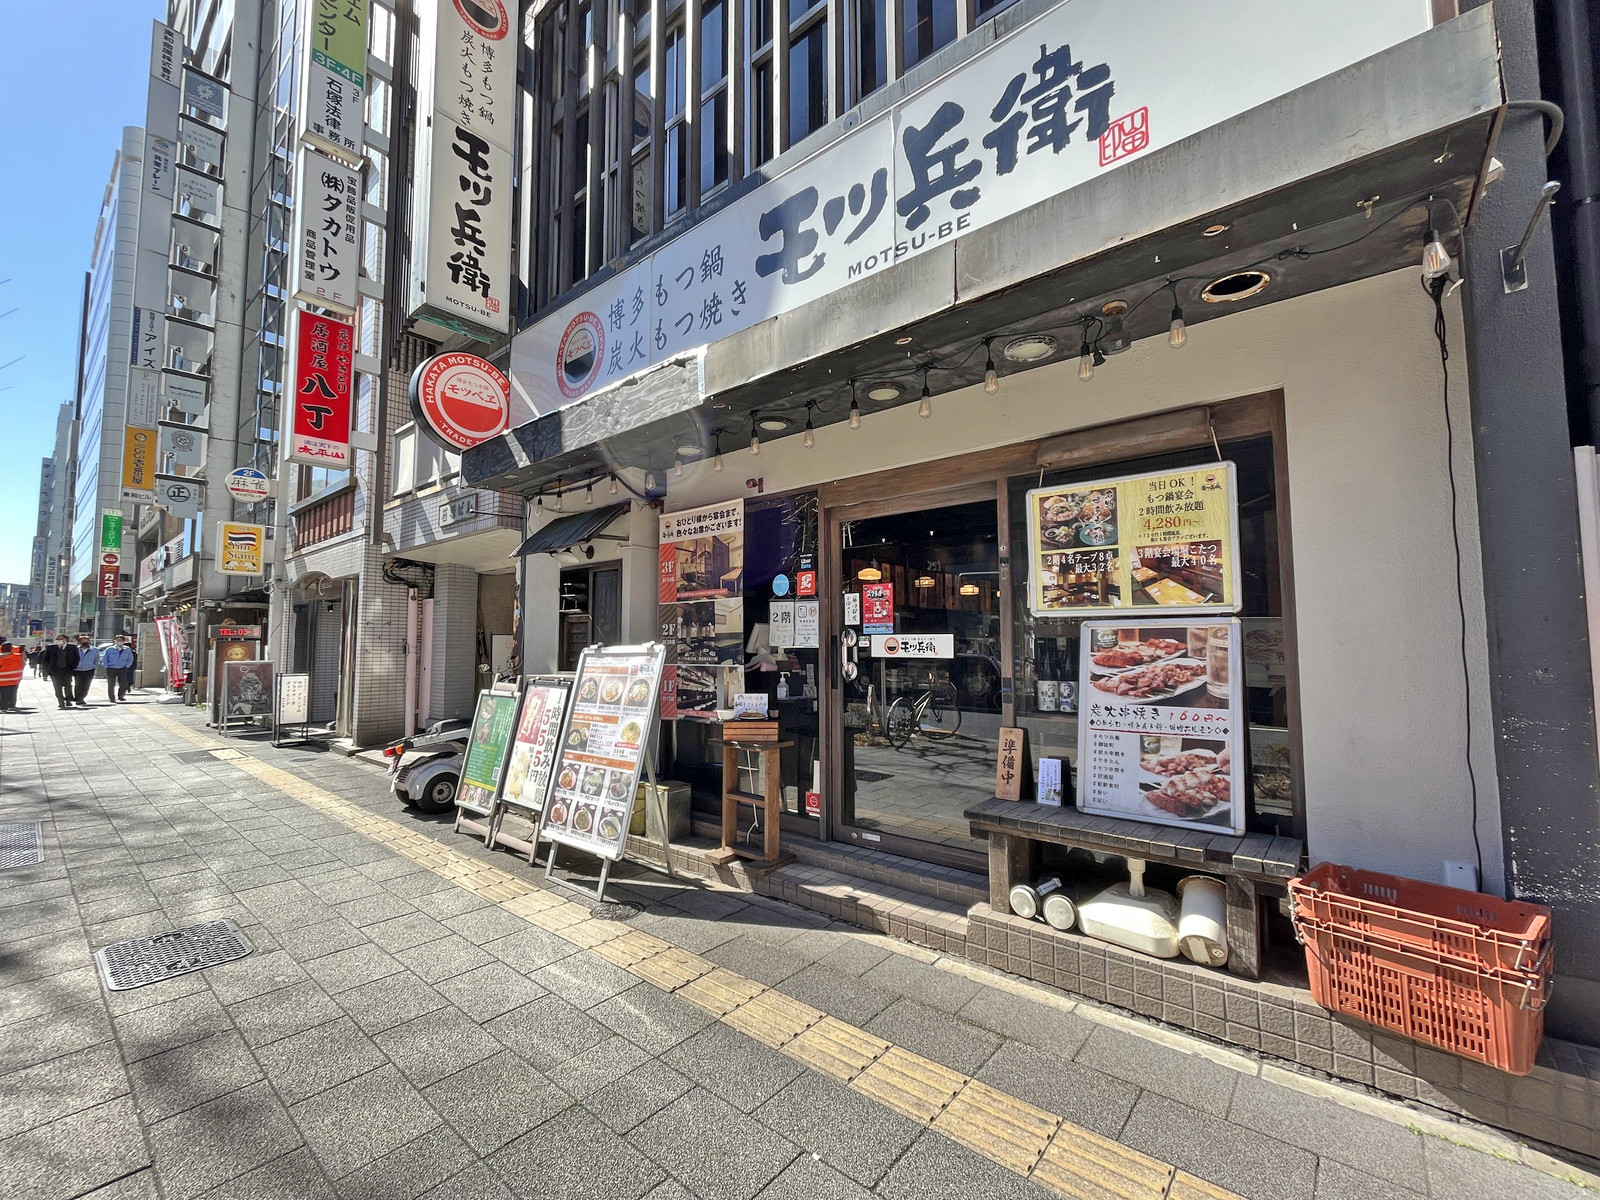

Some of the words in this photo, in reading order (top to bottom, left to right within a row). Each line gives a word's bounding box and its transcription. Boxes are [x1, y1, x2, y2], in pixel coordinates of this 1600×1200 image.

[458, 30, 477, 126] 炭火もつ焼き
[478, 42, 496, 126] 博多もつ鍋
[324, 76, 343, 131] 石塚法律
[312, 122, 355, 150] 事務所
[754, 43, 1116, 285] モツ兵衛
[446, 125, 493, 298] モツ兵衛
[304, 228, 317, 282] 商品管理室
[848, 212, 971, 280] MOTSU-BE
[607, 244, 724, 333] 博多もつ鍋
[445, 295, 492, 318] MOTSU-BE
[606, 280, 748, 376] 炭火もつ焼き
[143, 333, 157, 369] アイズ
[310, 321, 329, 372] 居酒屋
[557, 336, 567, 377] HAKATA
[425, 362, 448, 403] HAKATA
[447, 356, 505, 386] MOTSU-BE
[300, 373, 338, 431] 八丁
[440, 422, 472, 446] TRADE
[297, 445, 345, 460] 太平山
[231, 477, 266, 491] 麻雀
[243, 469, 255, 477] 2F
[123, 492, 152, 500] 東和ビル
[1147, 489, 1194, 504] もつ鍋宴会
[662, 561, 675, 574] 3F
[1075, 561, 1114, 574] 最大32名
[1171, 554, 1217, 568] 最大40名
[662, 624, 676, 637] 2F
[772, 611, 791, 624] 2階
[900, 641, 936, 654] モツ兵衛
[663, 680, 675, 692] 1F
[1090, 703, 1161, 720] 炭火串焼き
[1001, 738, 1018, 785] 準備中
